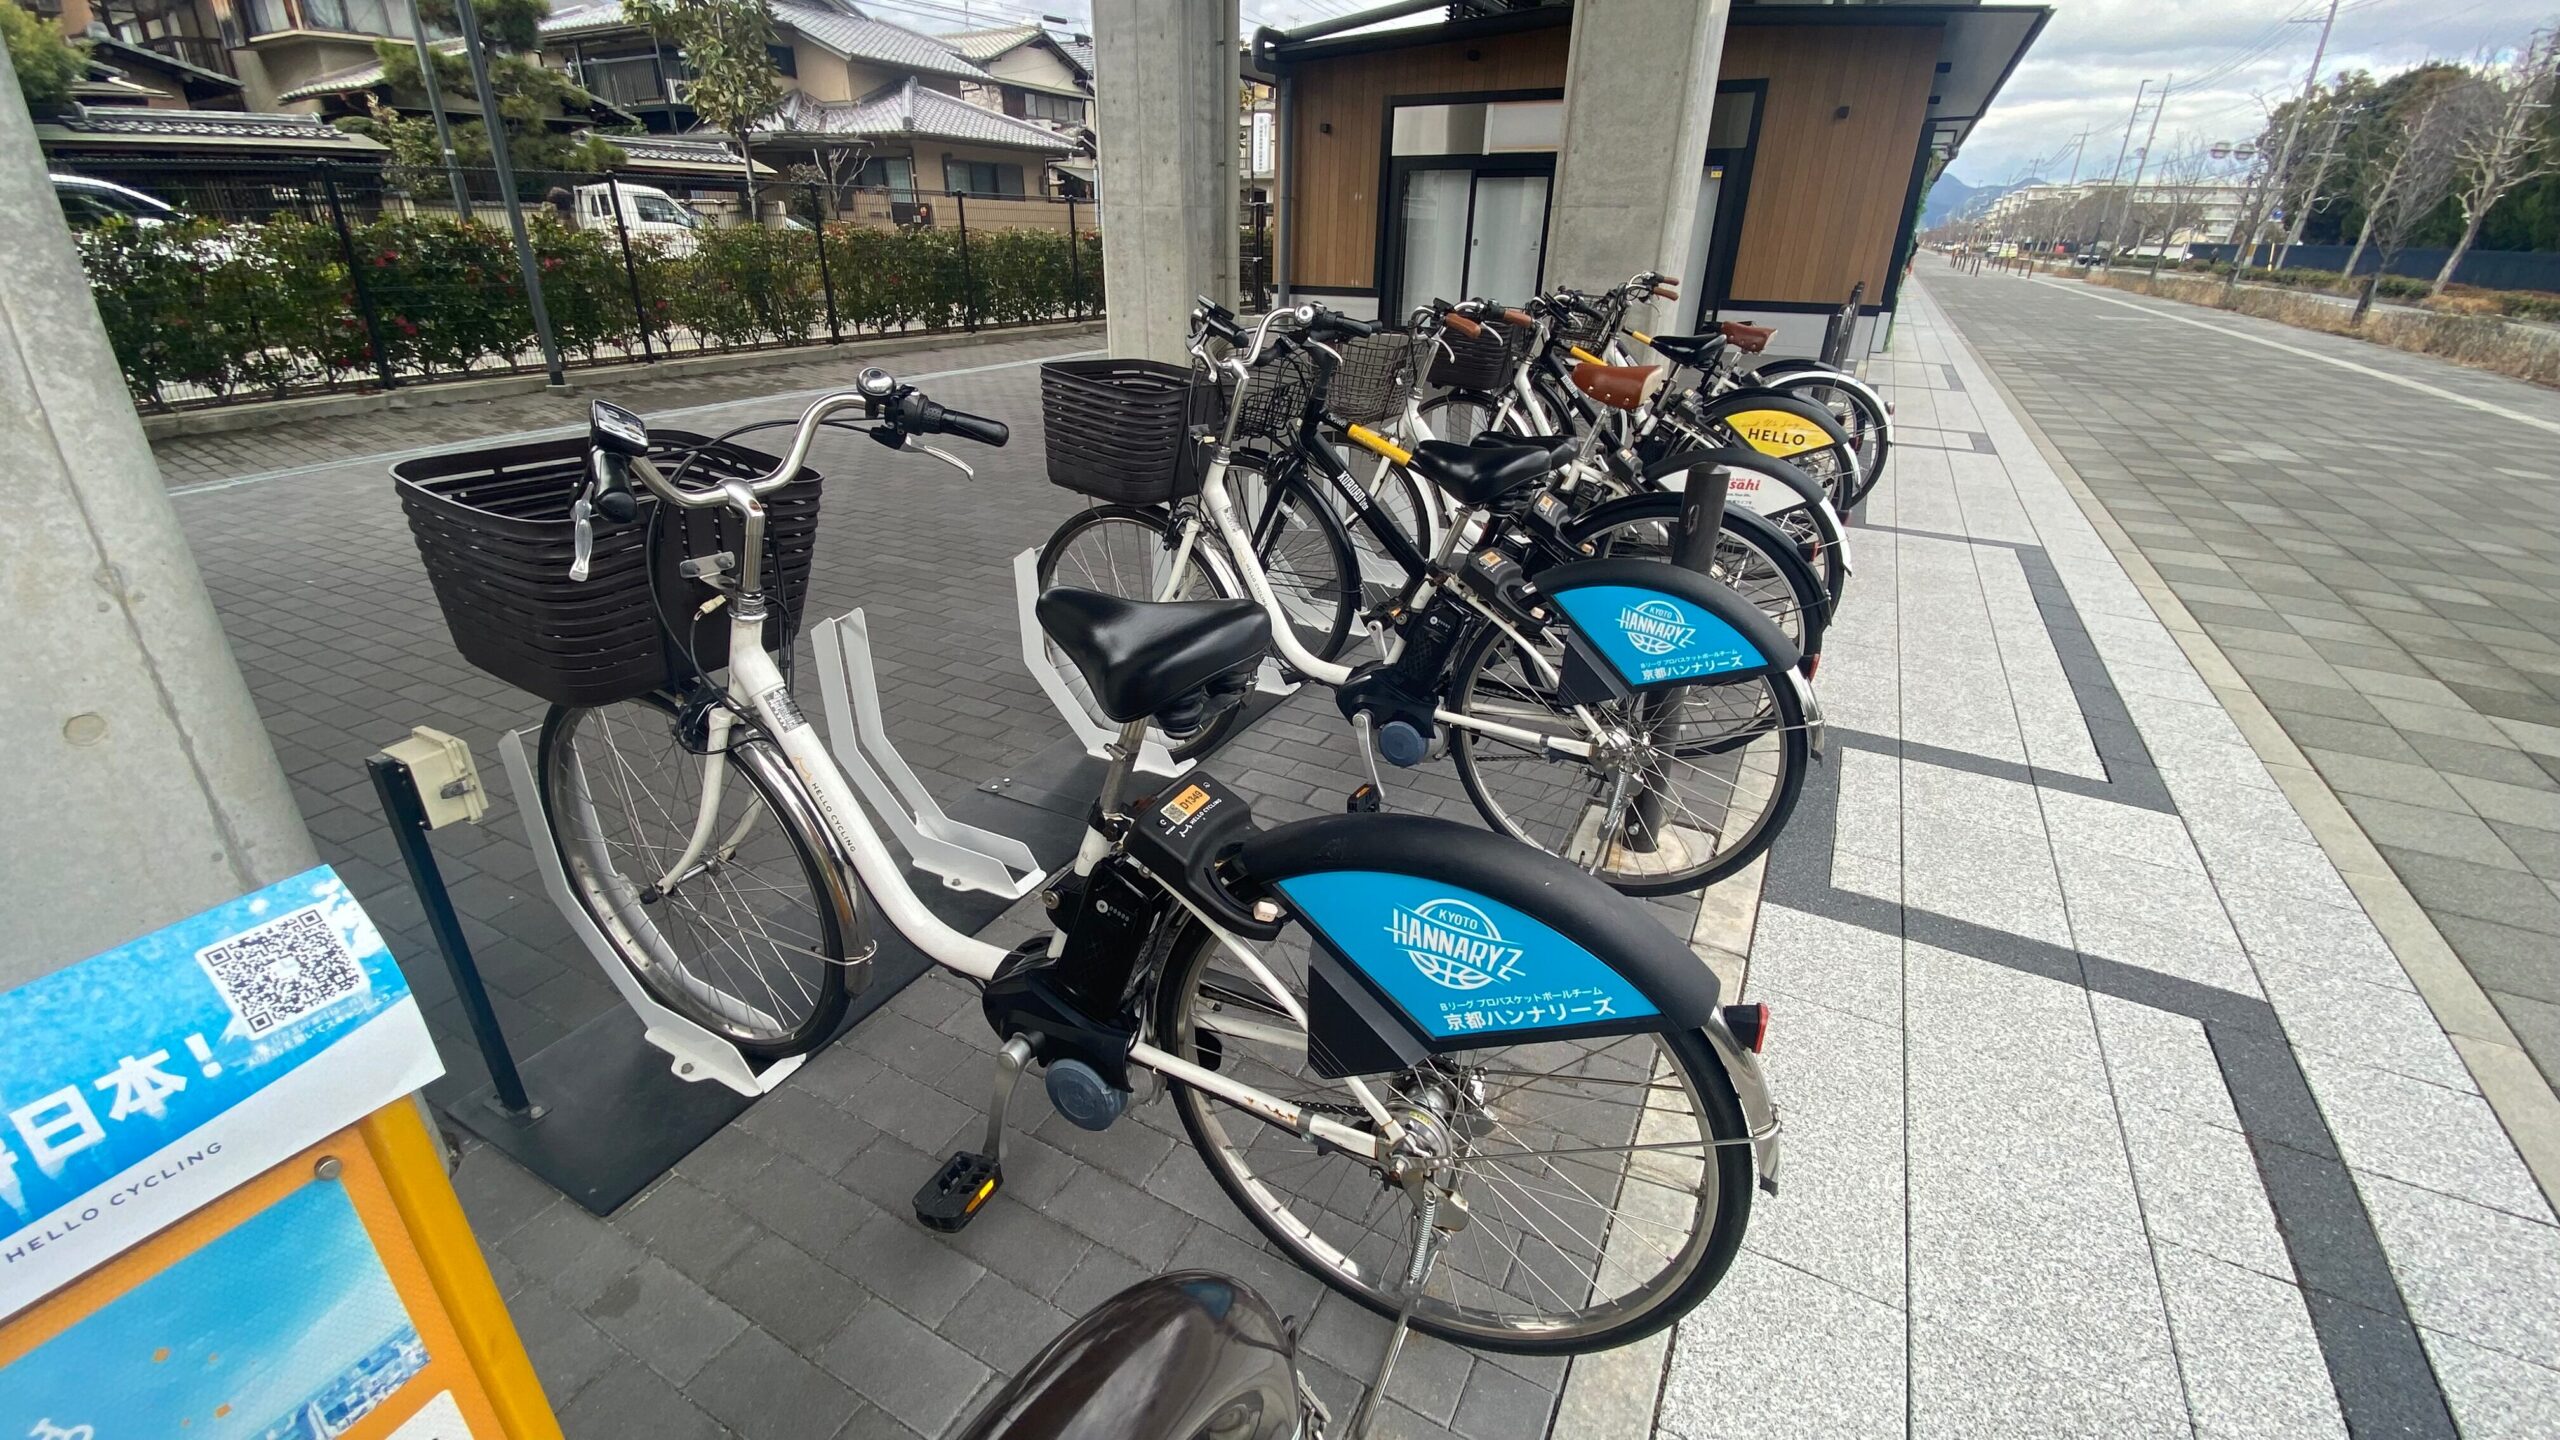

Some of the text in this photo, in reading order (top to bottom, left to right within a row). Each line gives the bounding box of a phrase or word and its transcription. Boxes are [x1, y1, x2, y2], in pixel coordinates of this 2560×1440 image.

[1748, 428, 1805, 446] HELLO
[1729, 479, 1761, 490] sahi
[1649, 606, 1673, 619] KYOTO
[1615, 608, 1696, 648] HANNARYZ
[1642, 655, 1743, 681] 京都ハンナリーズ
[1180, 790, 1203, 810] D1349
[811, 782, 856, 852] HELLO CYCLING
[1438, 908, 1478, 931] KYOTO
[1384, 907, 1526, 982] HANNARYZ
[1439, 986, 1603, 1012] Bリーグ プロバスケットボールチーム
[1443, 996, 1617, 1032] 京都ハンナリーズ
[5, 1141, 223, 1263] HELLO CYCLING
